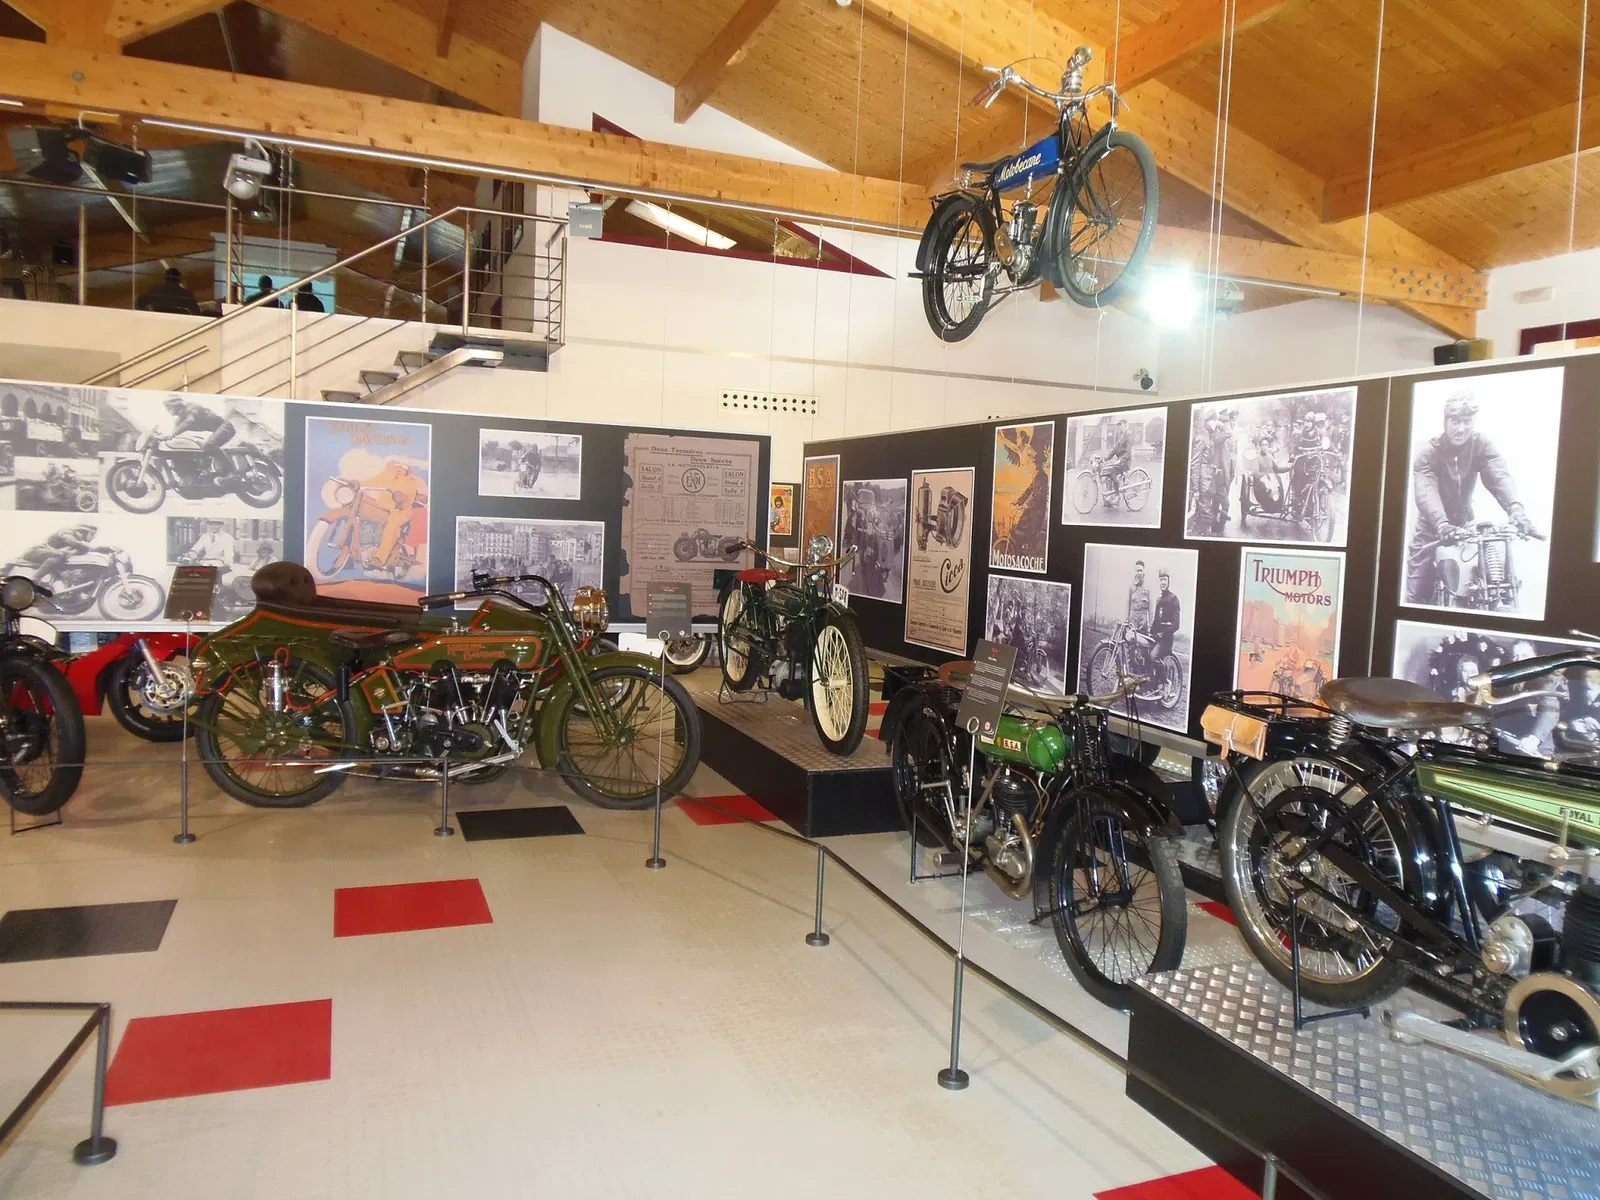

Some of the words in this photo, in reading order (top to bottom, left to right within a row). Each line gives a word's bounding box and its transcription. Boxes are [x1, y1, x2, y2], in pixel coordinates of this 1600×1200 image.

[641, 465, 661, 473] SALON
[992, 549, 1045, 571] MOTOSACOCHE
[1253, 559, 1321, 588] TRIUMPH
[1285, 591, 1332, 607] MOTORS
